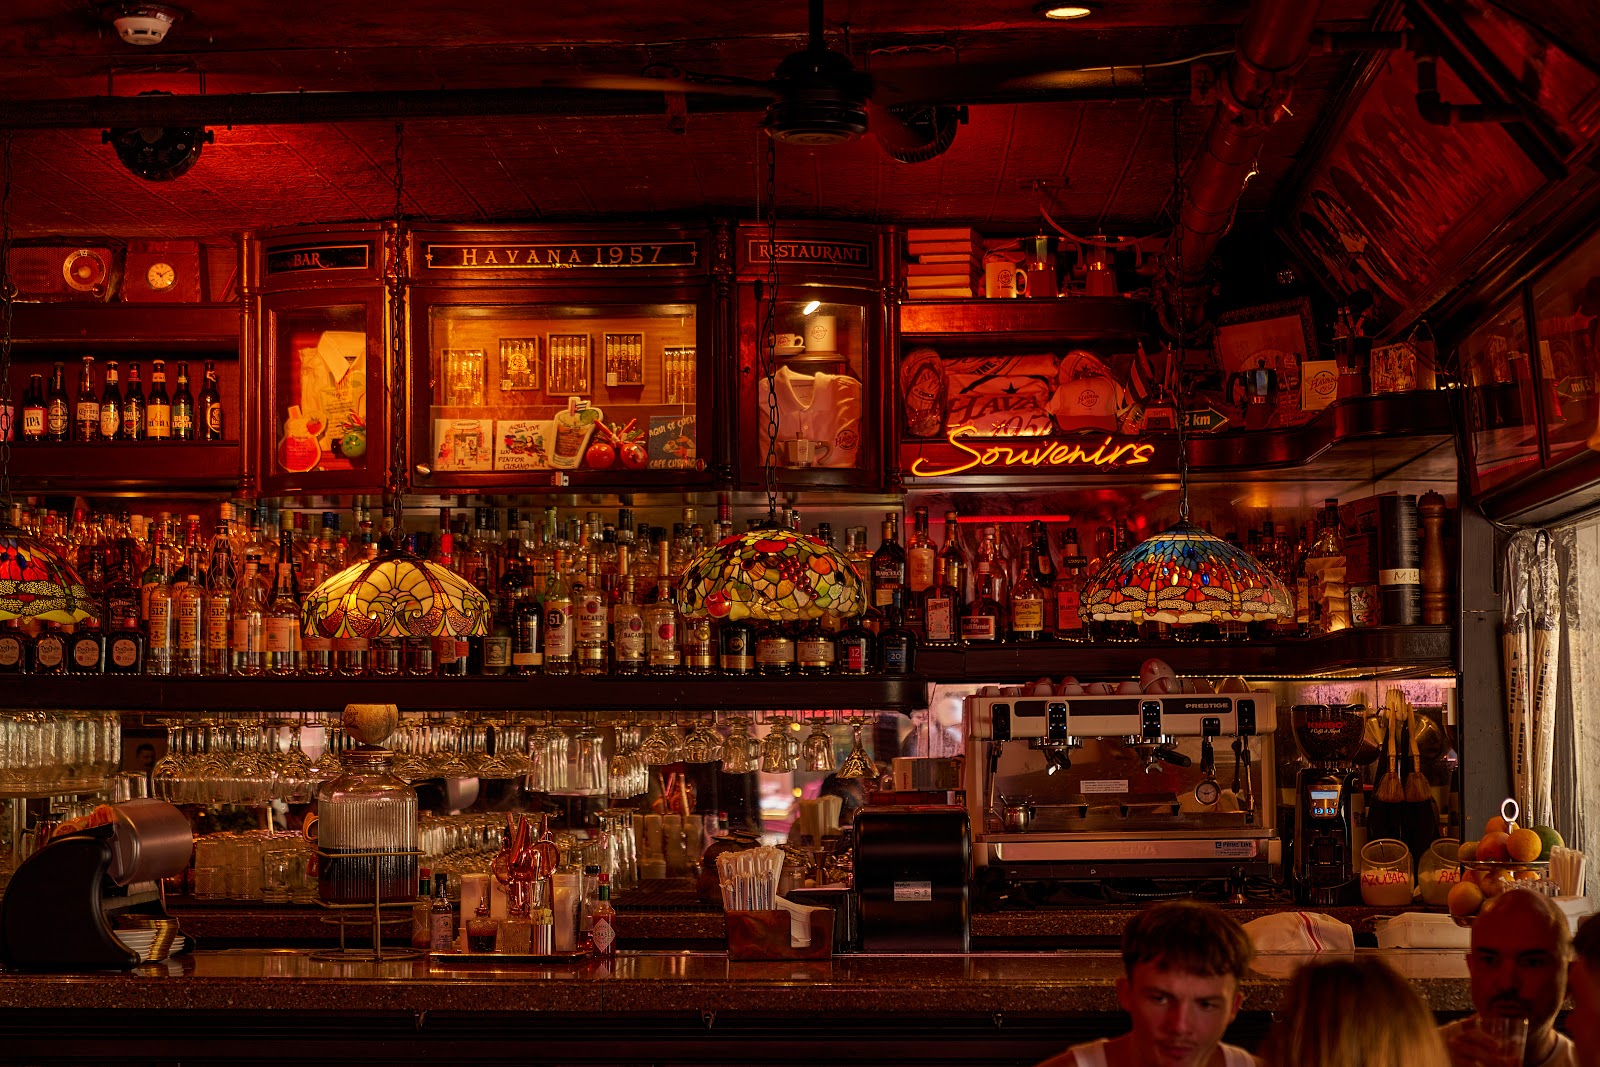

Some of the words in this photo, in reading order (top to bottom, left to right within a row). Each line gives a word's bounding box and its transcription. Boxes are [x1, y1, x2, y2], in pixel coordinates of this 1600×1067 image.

[293, 252, 329, 268] BAR
[462, 249, 581, 266] HAVANA
[596, 247, 662, 265] 1957
[759, 244, 862, 263] RESTAURANT
[944, 394, 1043, 425] HAVA
[26, 416, 41, 427] IPA
[172, 421, 193, 429] LIGHT
[1192, 413, 1211, 426] km
[649, 425, 666, 437] AQUI
[667, 421, 676, 431] SE
[911, 426, 1155, 477] Souvenirs
[548, 613, 561, 626] 51
[851, 648, 860, 657] 12
[890, 652, 902, 660] 20
[1307, 721, 1344, 729] KIMBO
